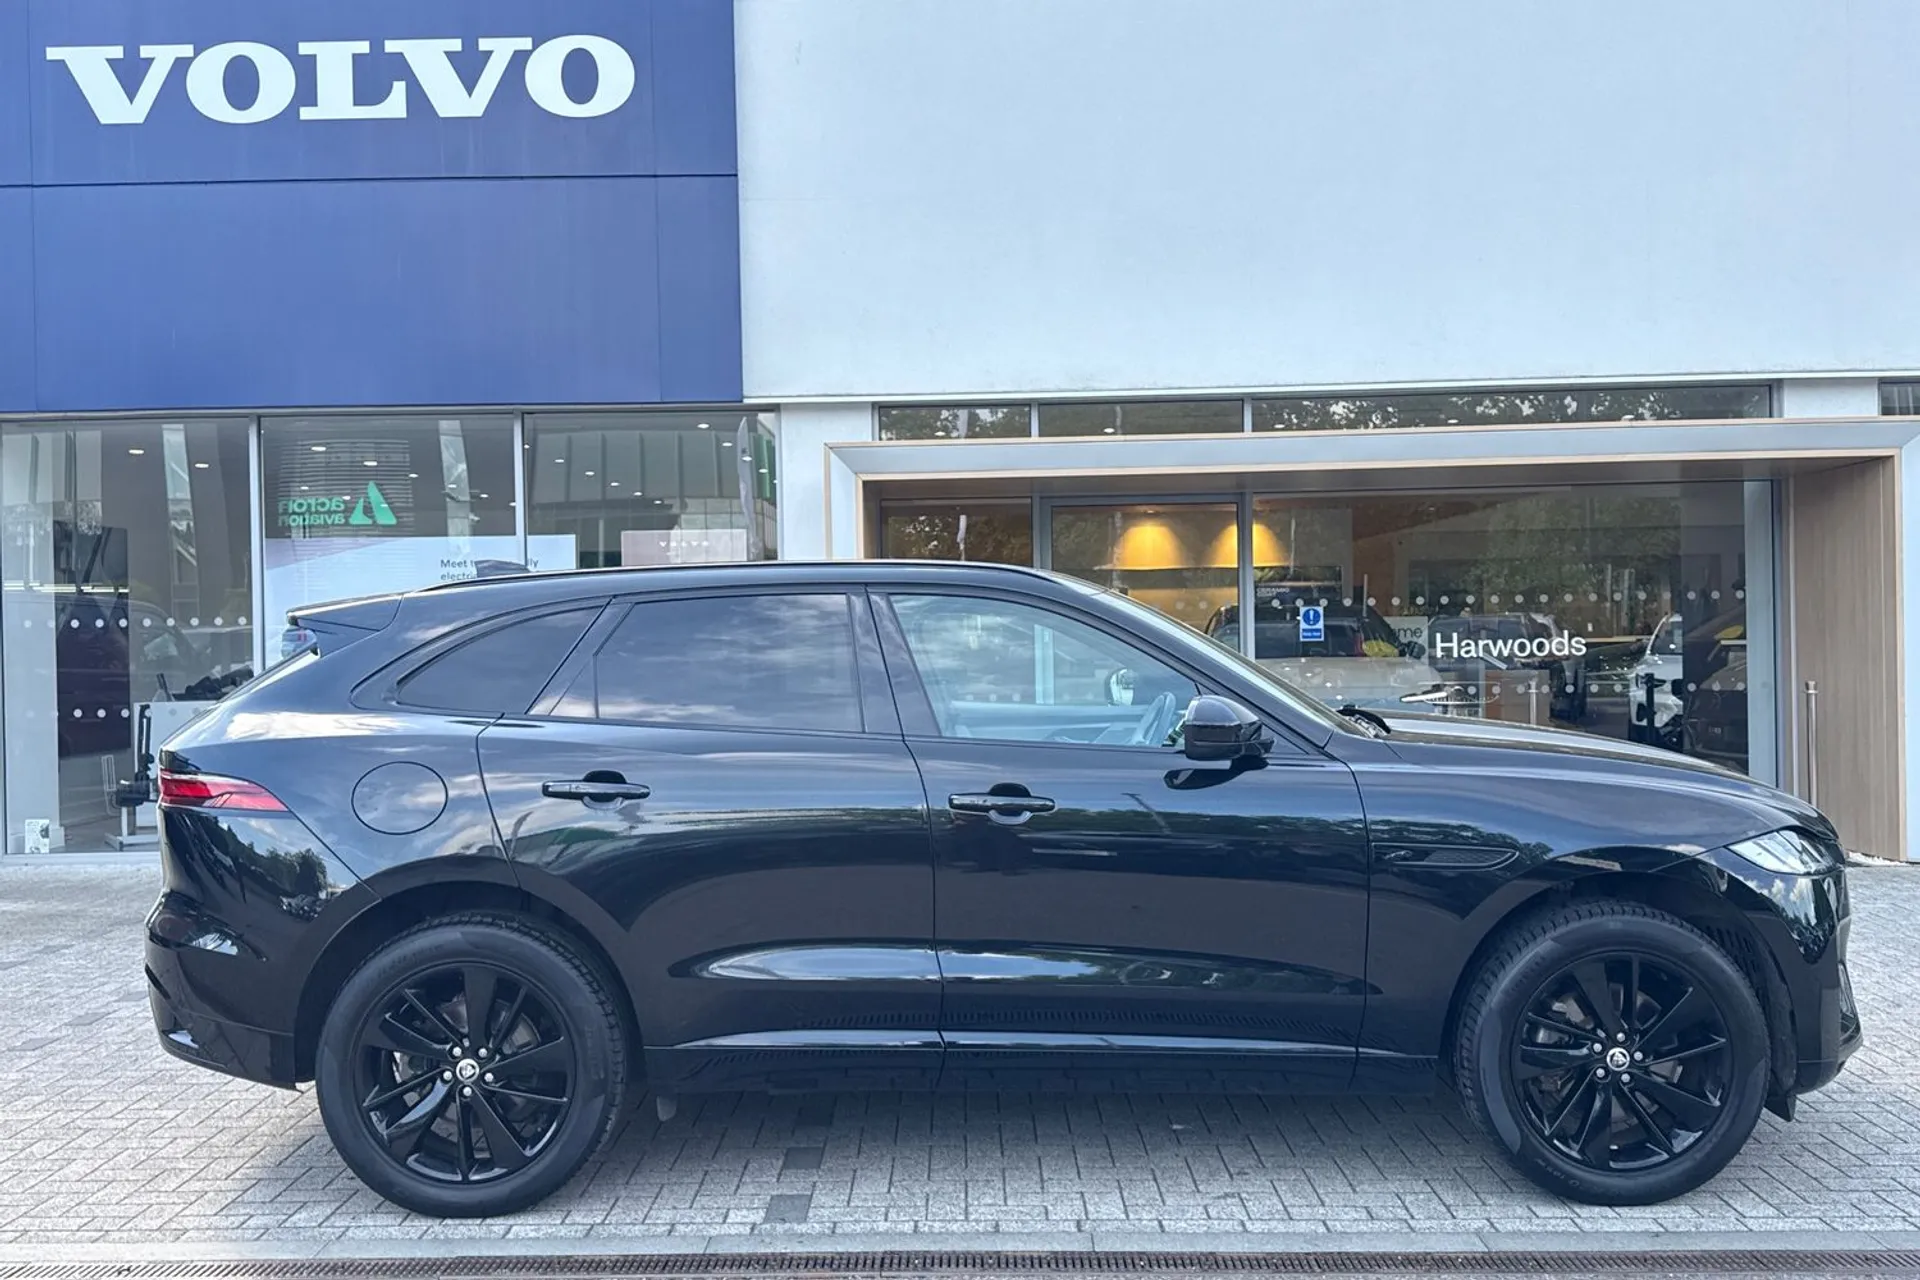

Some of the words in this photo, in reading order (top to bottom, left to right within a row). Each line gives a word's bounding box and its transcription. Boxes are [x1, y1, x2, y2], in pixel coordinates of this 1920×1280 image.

[46, 34, 635, 124] VOLVO
[440, 559, 468, 568] Meet
[1436, 630, 1587, 658] Harwoods
